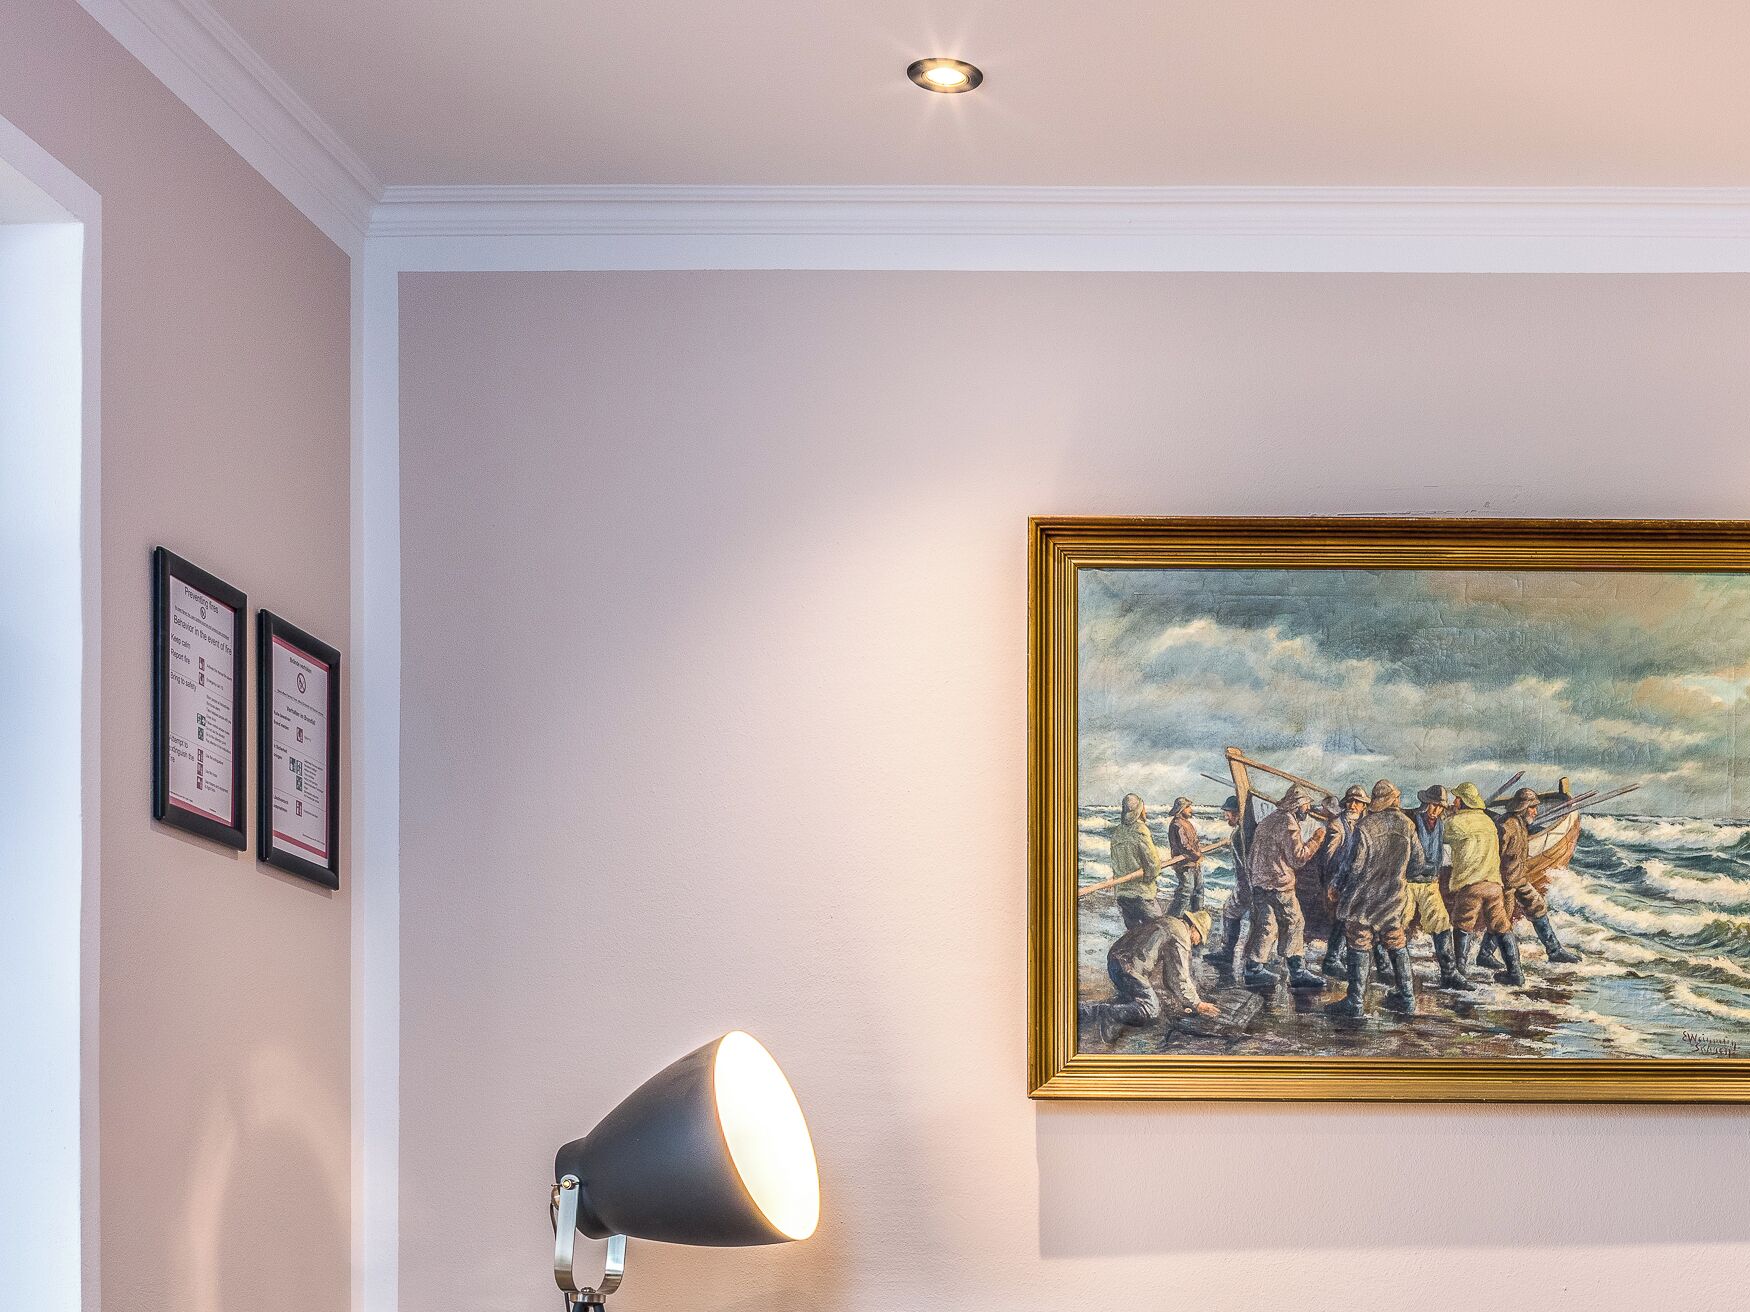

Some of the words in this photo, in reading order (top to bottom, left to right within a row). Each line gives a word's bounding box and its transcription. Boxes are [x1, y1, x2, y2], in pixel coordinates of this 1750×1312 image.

[184, 586, 209, 610] Preventing
[209, 601, 219, 614] fires
[170, 632, 181, 645] Keep
[173, 614, 194, 634] Behavior
[194, 625, 199, 636] in
[199, 628, 207, 641] the
[207, 636, 220, 649] event
[170, 648, 184, 660] Report
[170, 671, 180, 684] Bring
[185, 680, 197, 692] safety
